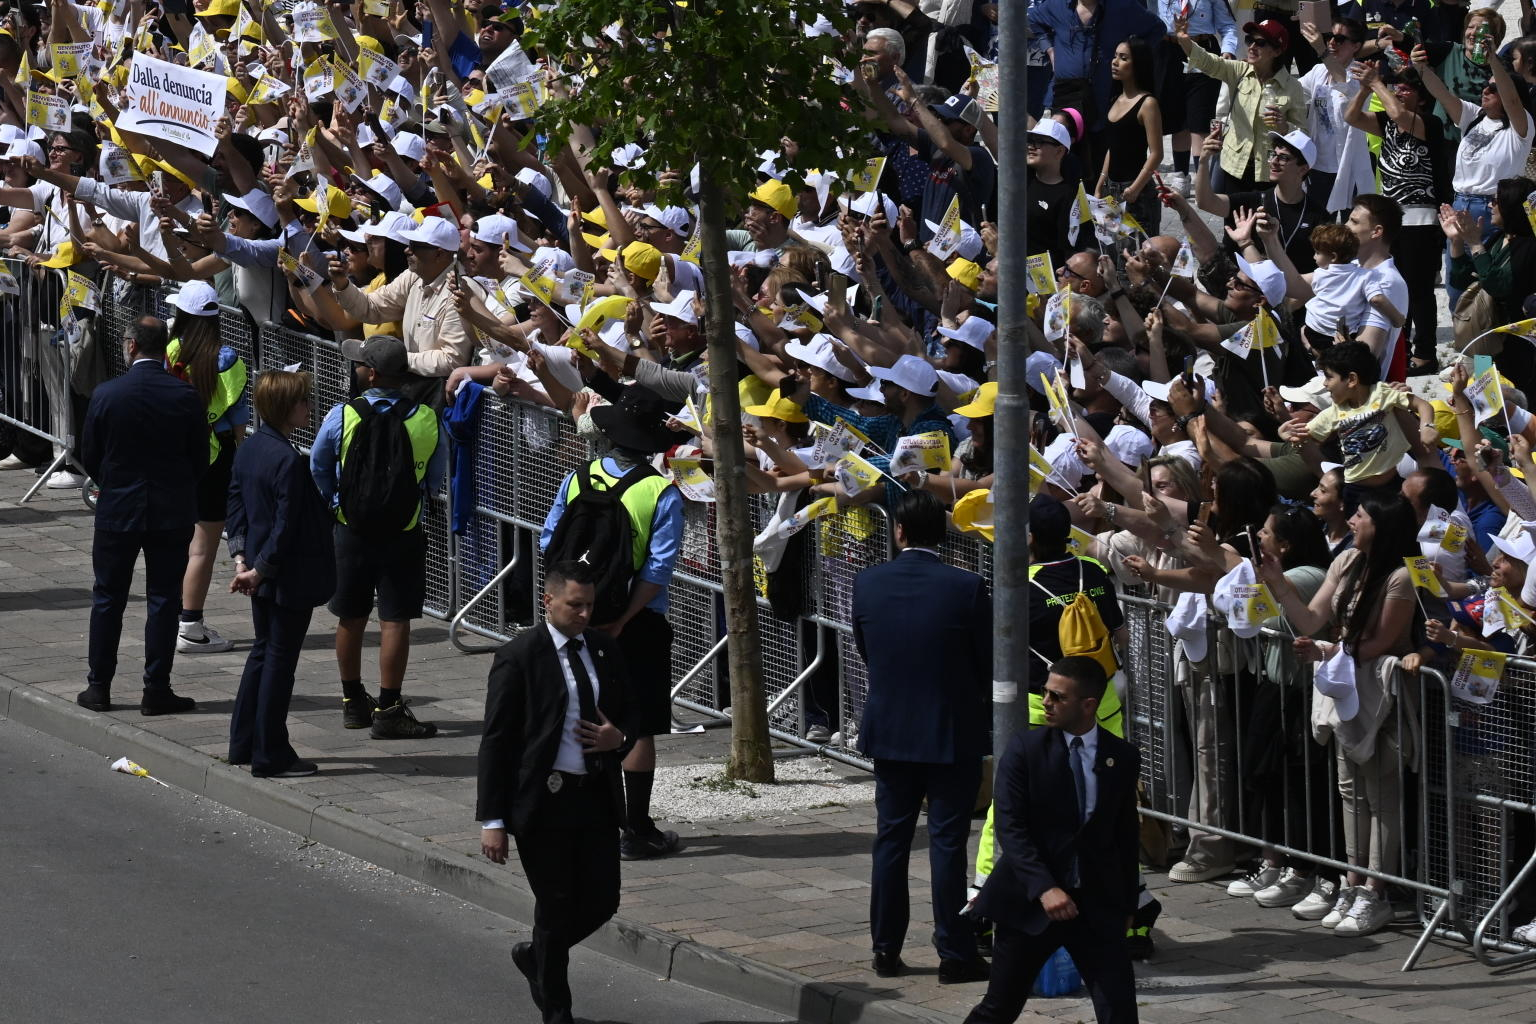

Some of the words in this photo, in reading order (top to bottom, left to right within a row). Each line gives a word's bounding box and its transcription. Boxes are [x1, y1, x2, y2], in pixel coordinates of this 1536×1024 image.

[57, 43, 91, 51] BENVENUTO
[334, 60, 362, 87] BENVENUTO
[133, 63, 161, 91] Dalla
[163, 73, 213, 106] denuncia
[32, 94, 64, 104] BENVENUTO
[1089, 586, 1105, 597] CIVILE
